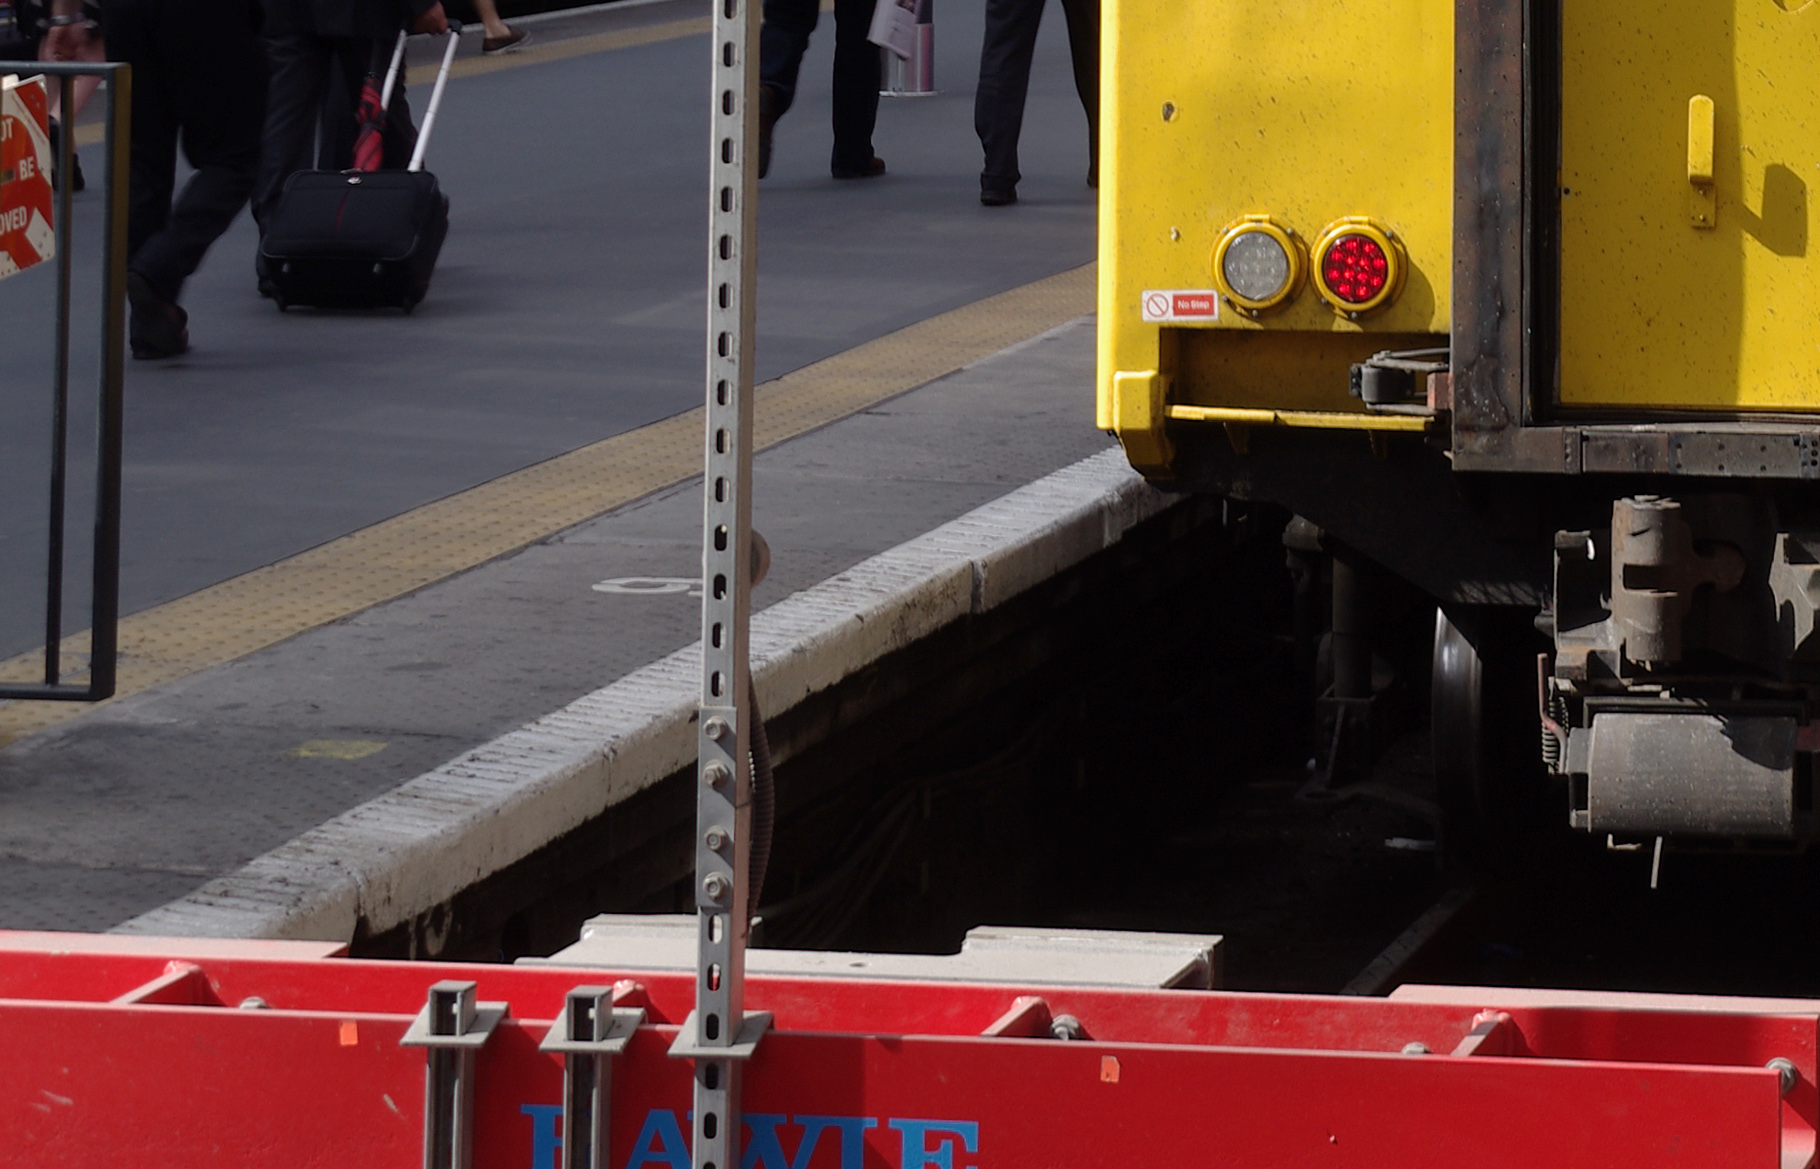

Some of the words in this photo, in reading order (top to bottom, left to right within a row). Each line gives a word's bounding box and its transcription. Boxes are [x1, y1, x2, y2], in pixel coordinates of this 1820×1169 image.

[19, 156, 36, 181] BE
[1177, 299, 1190, 310] No
[1191, 299, 1210, 312] Step
